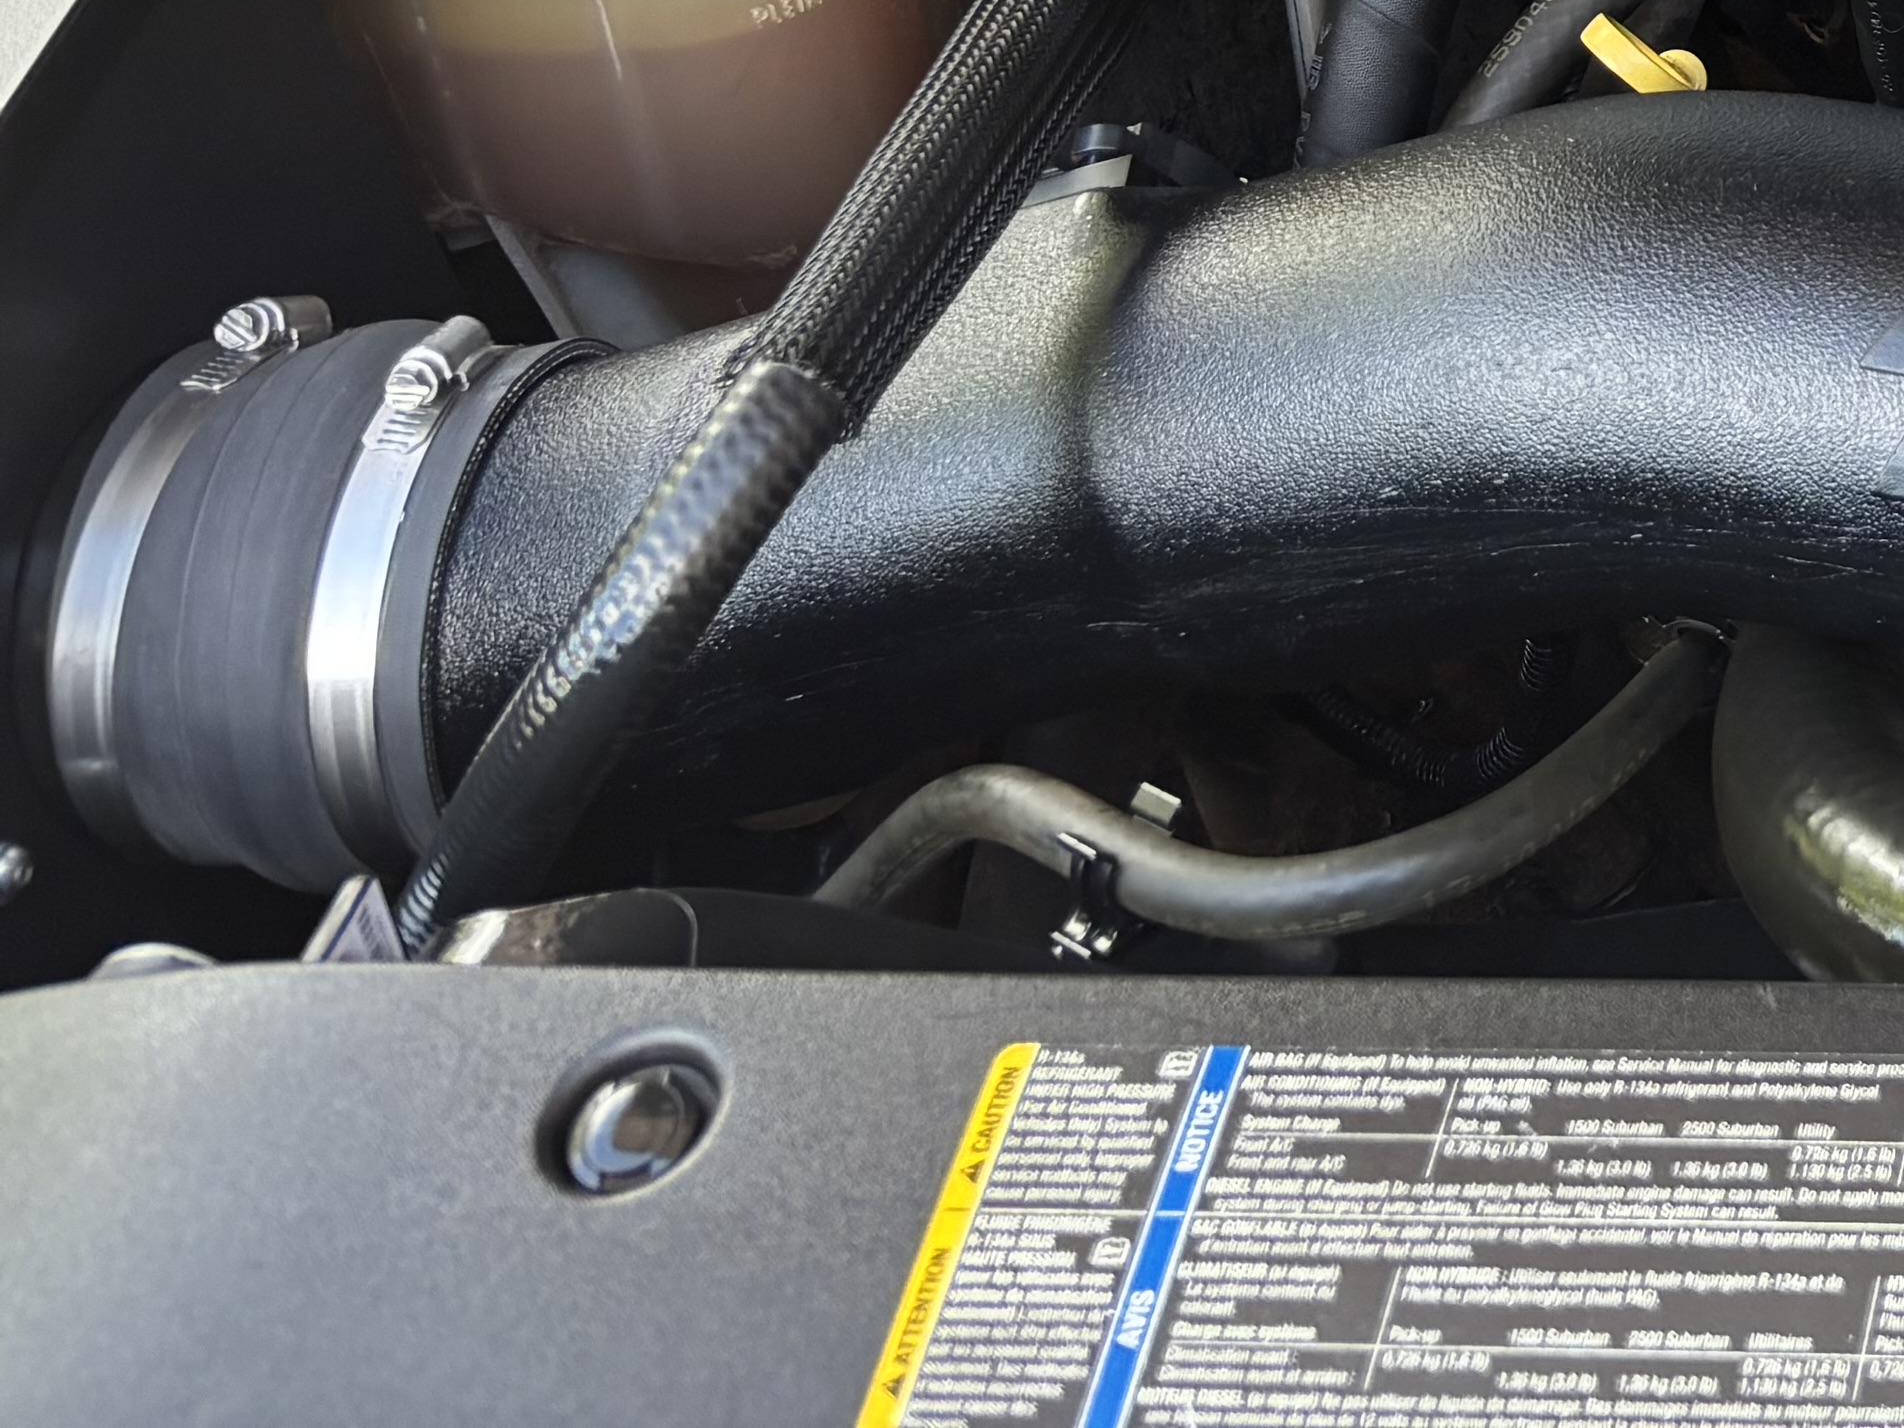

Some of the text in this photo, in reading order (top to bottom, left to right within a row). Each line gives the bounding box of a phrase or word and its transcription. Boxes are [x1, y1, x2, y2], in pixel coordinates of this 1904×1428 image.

[1590, 1059, 1616, 1072] see
[1615, 1057, 1666, 1072] Service
[1664, 1058, 1715, 1073] Manual
[1713, 1059, 1738, 1073] for
[1734, 1059, 1803, 1077] diagnostic
[1801, 1060, 1829, 1075] and
[1828, 1060, 1876, 1075] service
[972, 1066, 1020, 1154] CAUTION
[1172, 1088, 1225, 1173] NOTICE
[1565, 1118, 1666, 1136] 1500 Suburban
[1678, 1120, 1782, 1138] 2500 Suburban
[1794, 1122, 1838, 1140] Utility
[1789, 1144, 1897, 1164] 0.726 kg (1.6 lb)
[1787, 1162, 1894, 1182] 1.130 kg (2.5 lb)
[1836, 1189, 1880, 1207] apply
[899, 1248, 951, 1364] ATTENTION
[1112, 1288, 1158, 1349] AVIS
